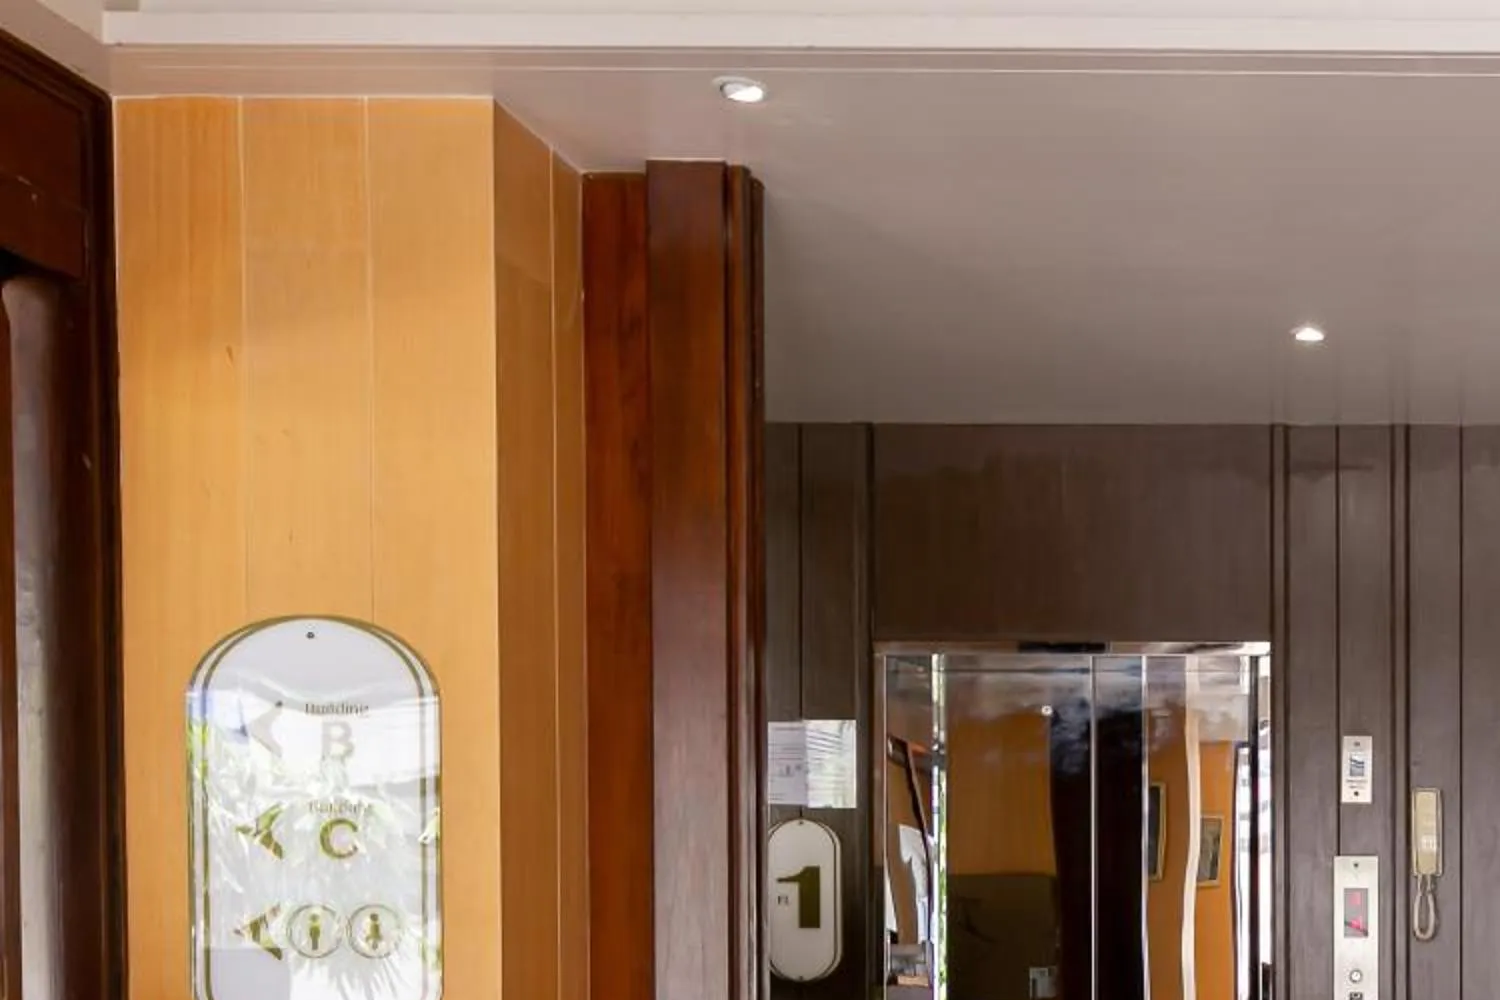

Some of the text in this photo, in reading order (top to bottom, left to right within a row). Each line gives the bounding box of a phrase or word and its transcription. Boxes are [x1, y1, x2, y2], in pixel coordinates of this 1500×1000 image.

[321, 721, 355, 762] B
[320, 818, 358, 860] C
[776, 866, 821, 929] 1
